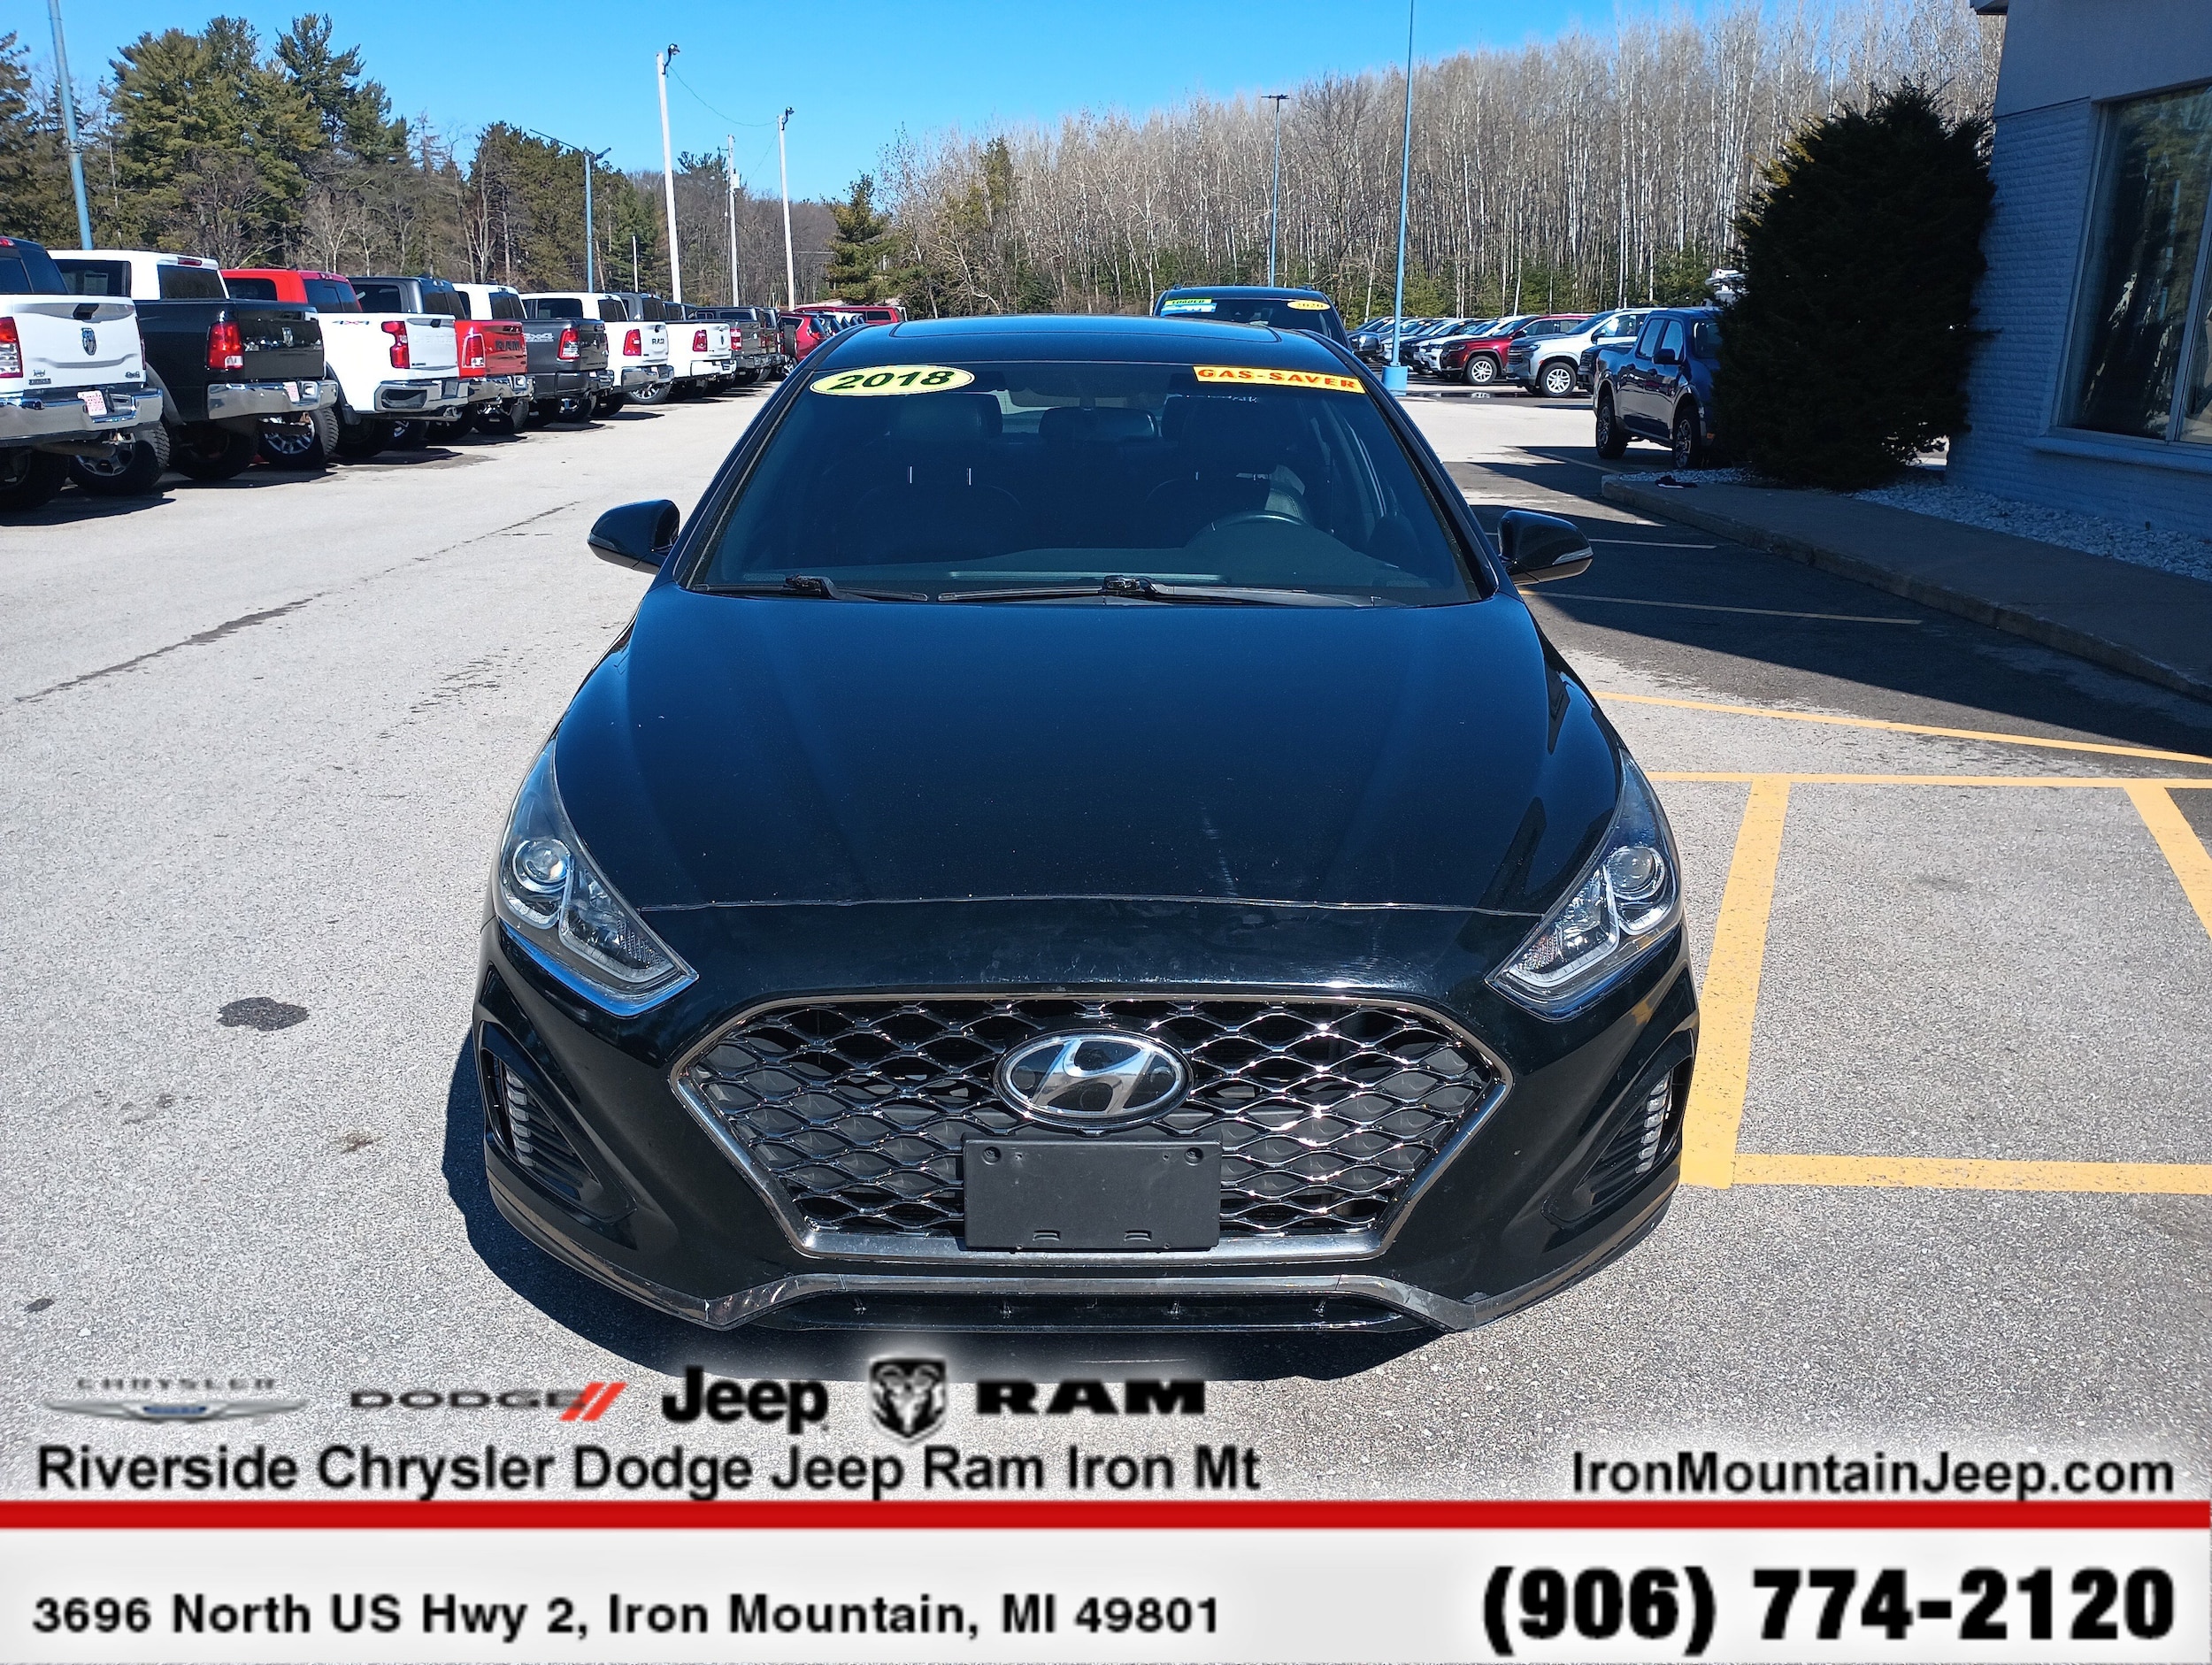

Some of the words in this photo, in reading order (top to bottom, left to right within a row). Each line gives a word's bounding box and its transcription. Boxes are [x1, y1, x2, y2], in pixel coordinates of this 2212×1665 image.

[494, 339, 521, 351] RAM
[826, 370, 956, 391] 2018
[1197, 368, 1359, 389] GAS-SAVER
